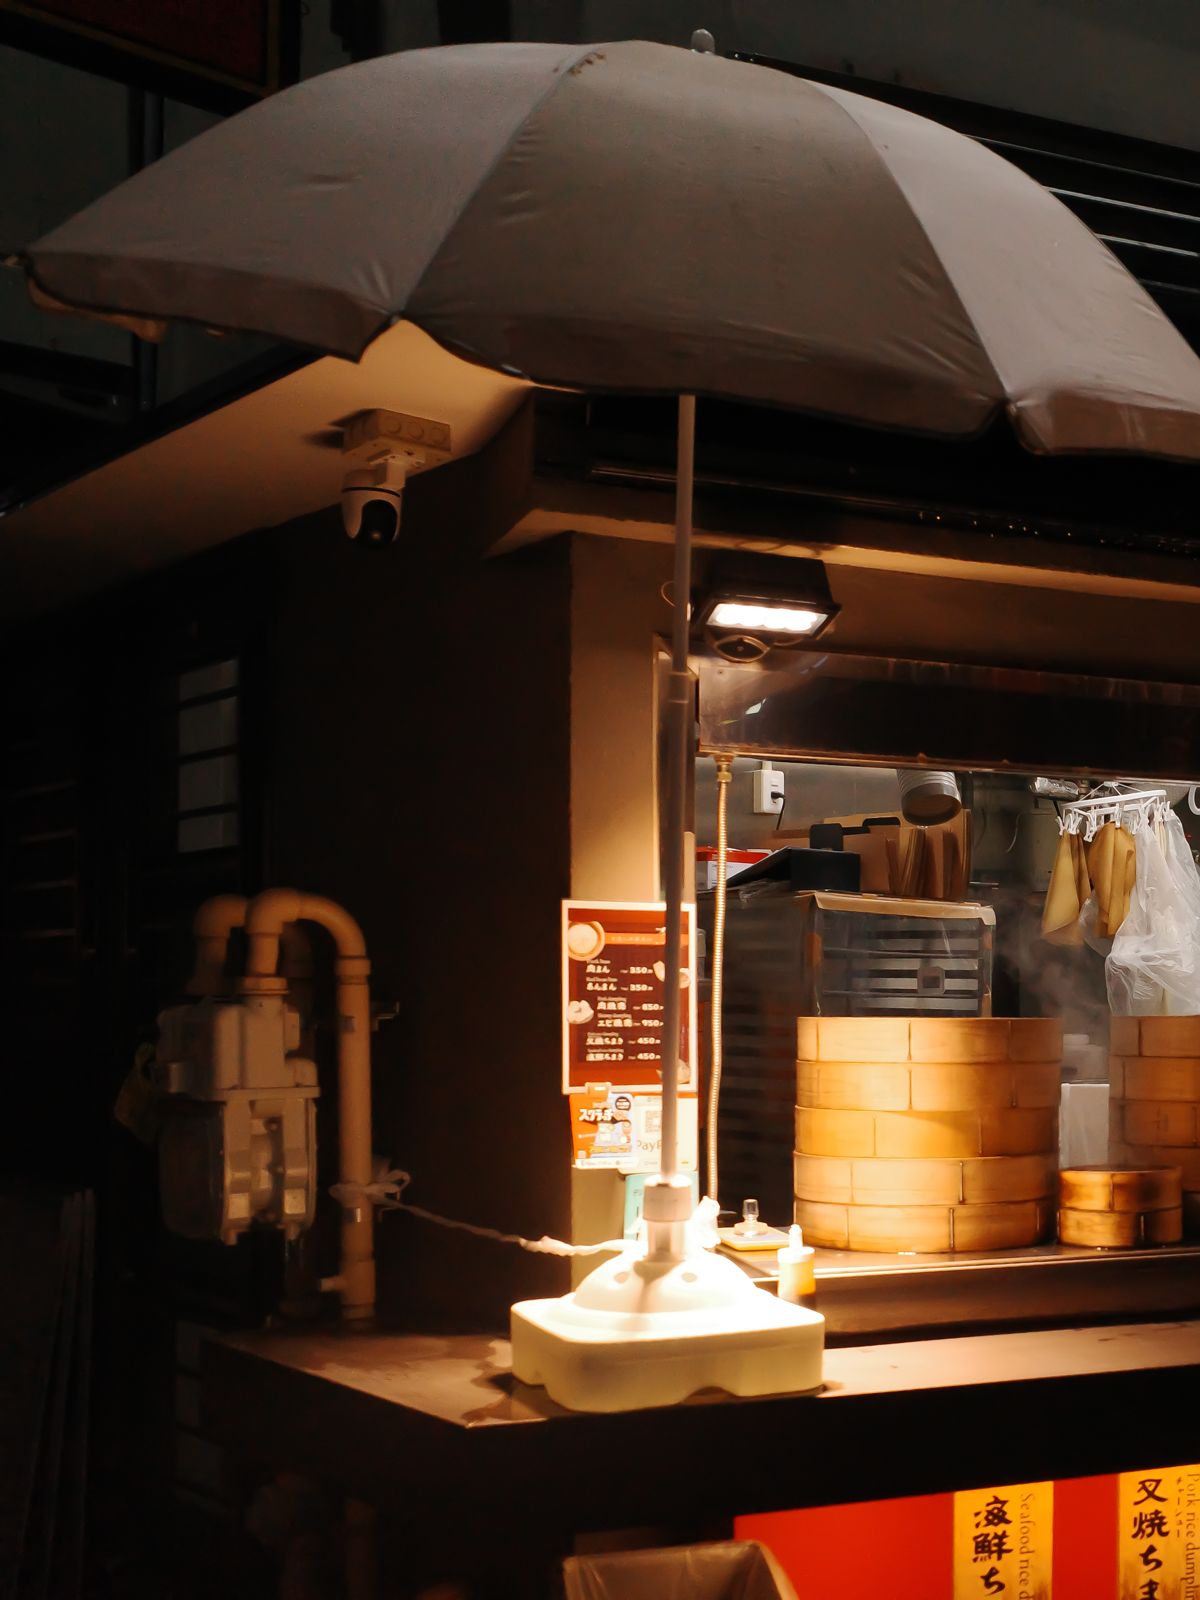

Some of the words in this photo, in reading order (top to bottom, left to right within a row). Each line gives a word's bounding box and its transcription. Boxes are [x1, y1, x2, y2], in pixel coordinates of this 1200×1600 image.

[1186, 1473, 1200, 1507] Pork
[1019, 1493, 1036, 1555] Seafood
[1186, 1512, 1199, 1538] rice
[972, 1495, 1014, 1596] 海鮮ち
[1019, 1559, 1032, 1586] rice
